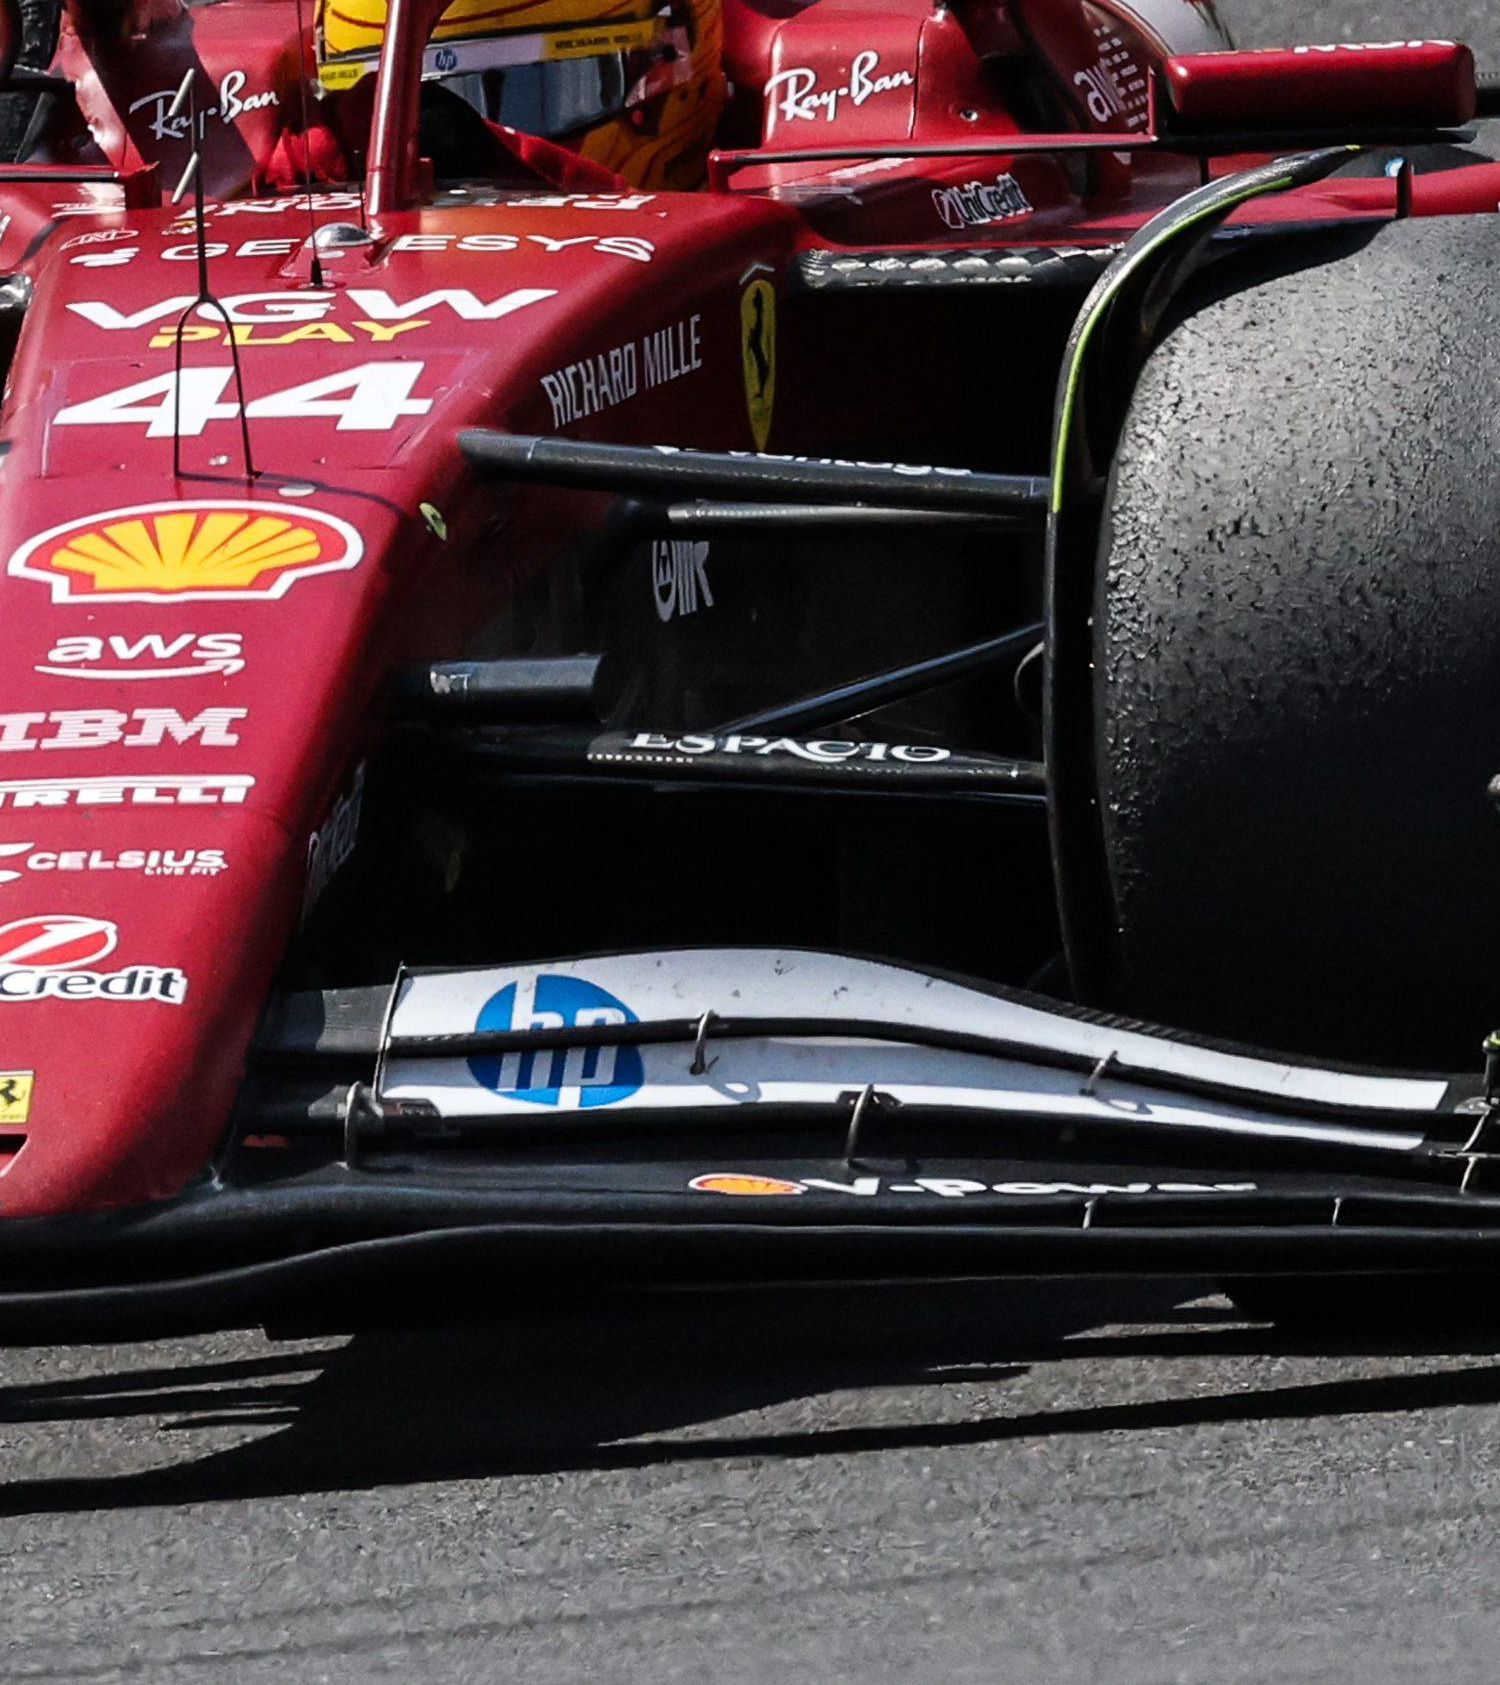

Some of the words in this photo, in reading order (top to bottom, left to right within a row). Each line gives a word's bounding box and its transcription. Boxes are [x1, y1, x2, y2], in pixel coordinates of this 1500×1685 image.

[763, 51, 916, 123] Ray-Ban
[160, 234, 656, 262] GEESYS
[147, 320, 433, 349] PLAY
[540, 343, 638, 429] RICHARD
[644, 313, 703, 385] MILLE
[51, 360, 436, 438] 44
[47, 632, 243, 664] aws
[629, 732, 951, 763] ESPACIO
[26, 849, 229, 871] CELSIUS
